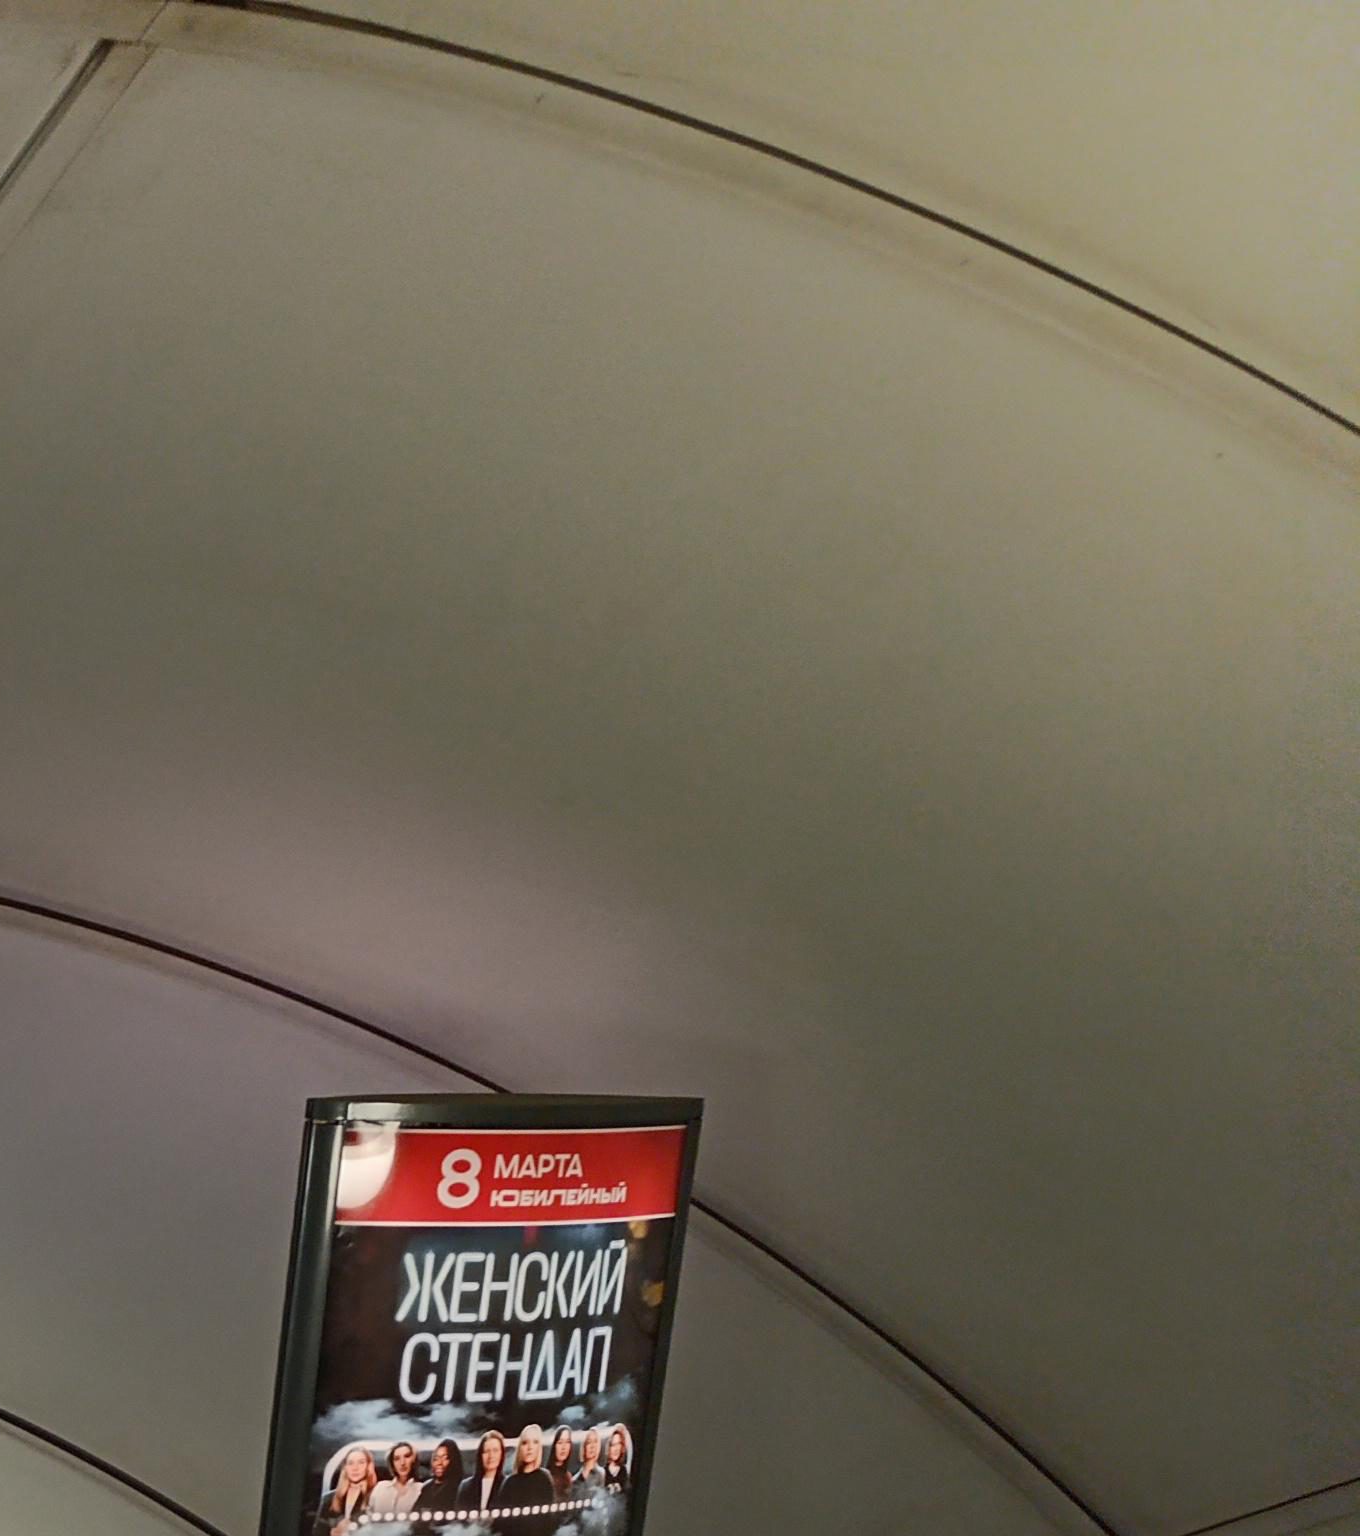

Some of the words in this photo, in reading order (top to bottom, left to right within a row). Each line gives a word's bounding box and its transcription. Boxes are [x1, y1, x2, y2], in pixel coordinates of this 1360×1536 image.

[437, 1148, 482, 1208] 8
[493, 1153, 583, 1179] МАРТА
[490, 1181, 628, 1207] ЮБИЛЕЙНЫЙ
[395, 1239, 628, 1323] ЖЕНСКИЙ
[398, 1327, 613, 1404] СТЕНДАП
